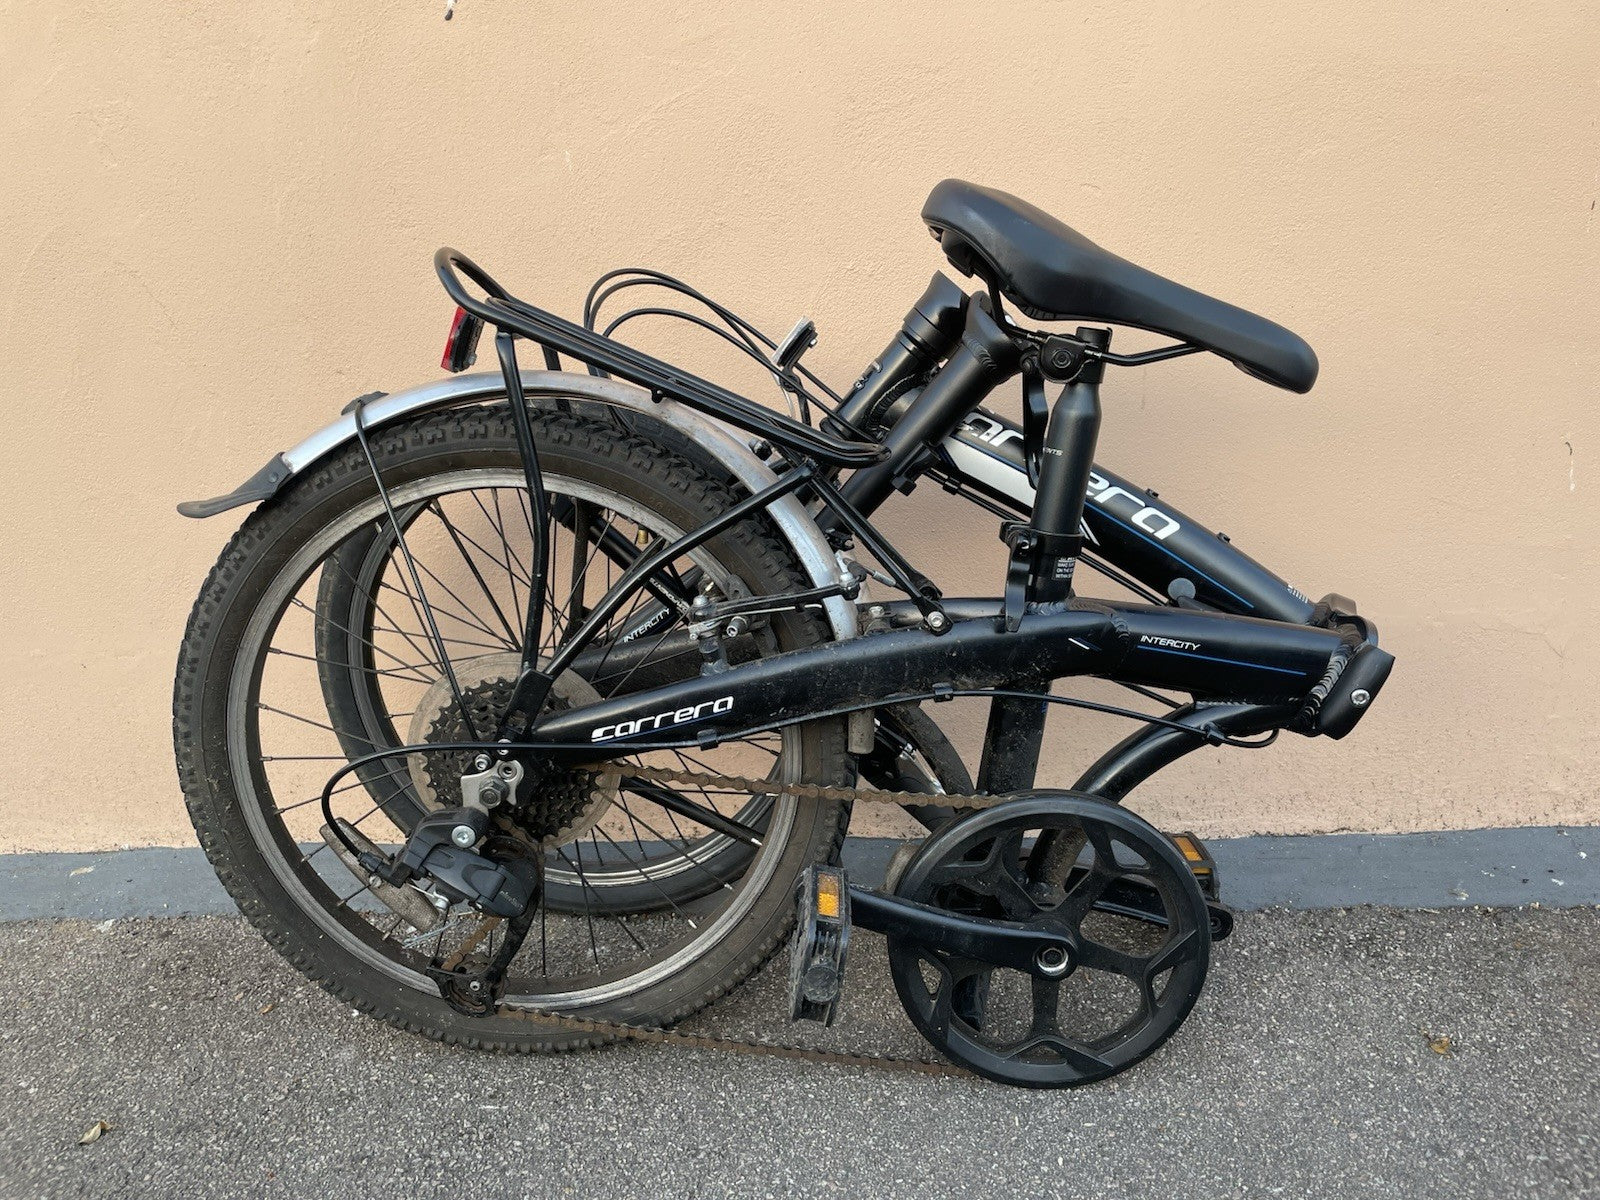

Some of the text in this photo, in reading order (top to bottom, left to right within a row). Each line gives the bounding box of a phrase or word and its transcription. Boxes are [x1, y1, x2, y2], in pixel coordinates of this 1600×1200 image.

[623, 607, 670, 643] INTERCITY
[1140, 634, 1201, 651] INTERCITY
[591, 696, 734, 743] carrera
